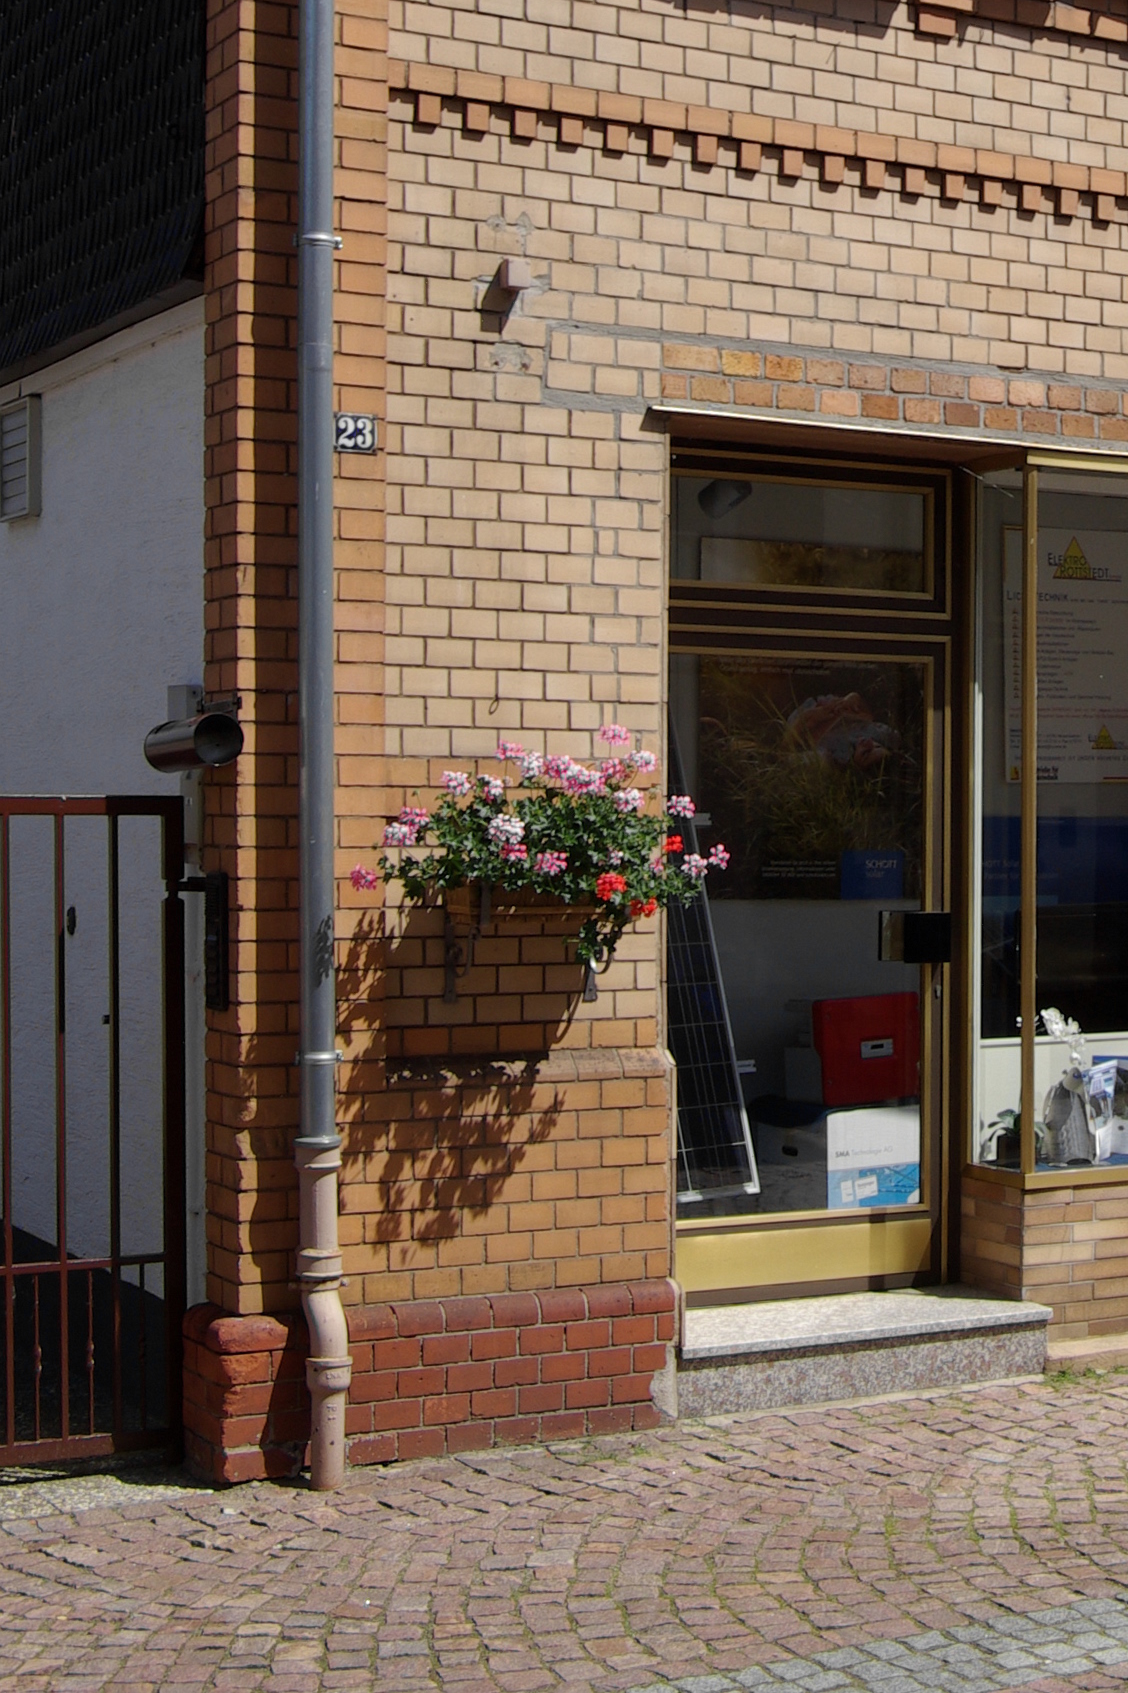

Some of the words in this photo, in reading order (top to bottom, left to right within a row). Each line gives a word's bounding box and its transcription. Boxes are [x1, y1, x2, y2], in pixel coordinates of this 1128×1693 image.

[337, 416, 374, 450] 23
[865, 858, 897, 869] SCHOTT
[835, 1151, 850, 1159] SMA
